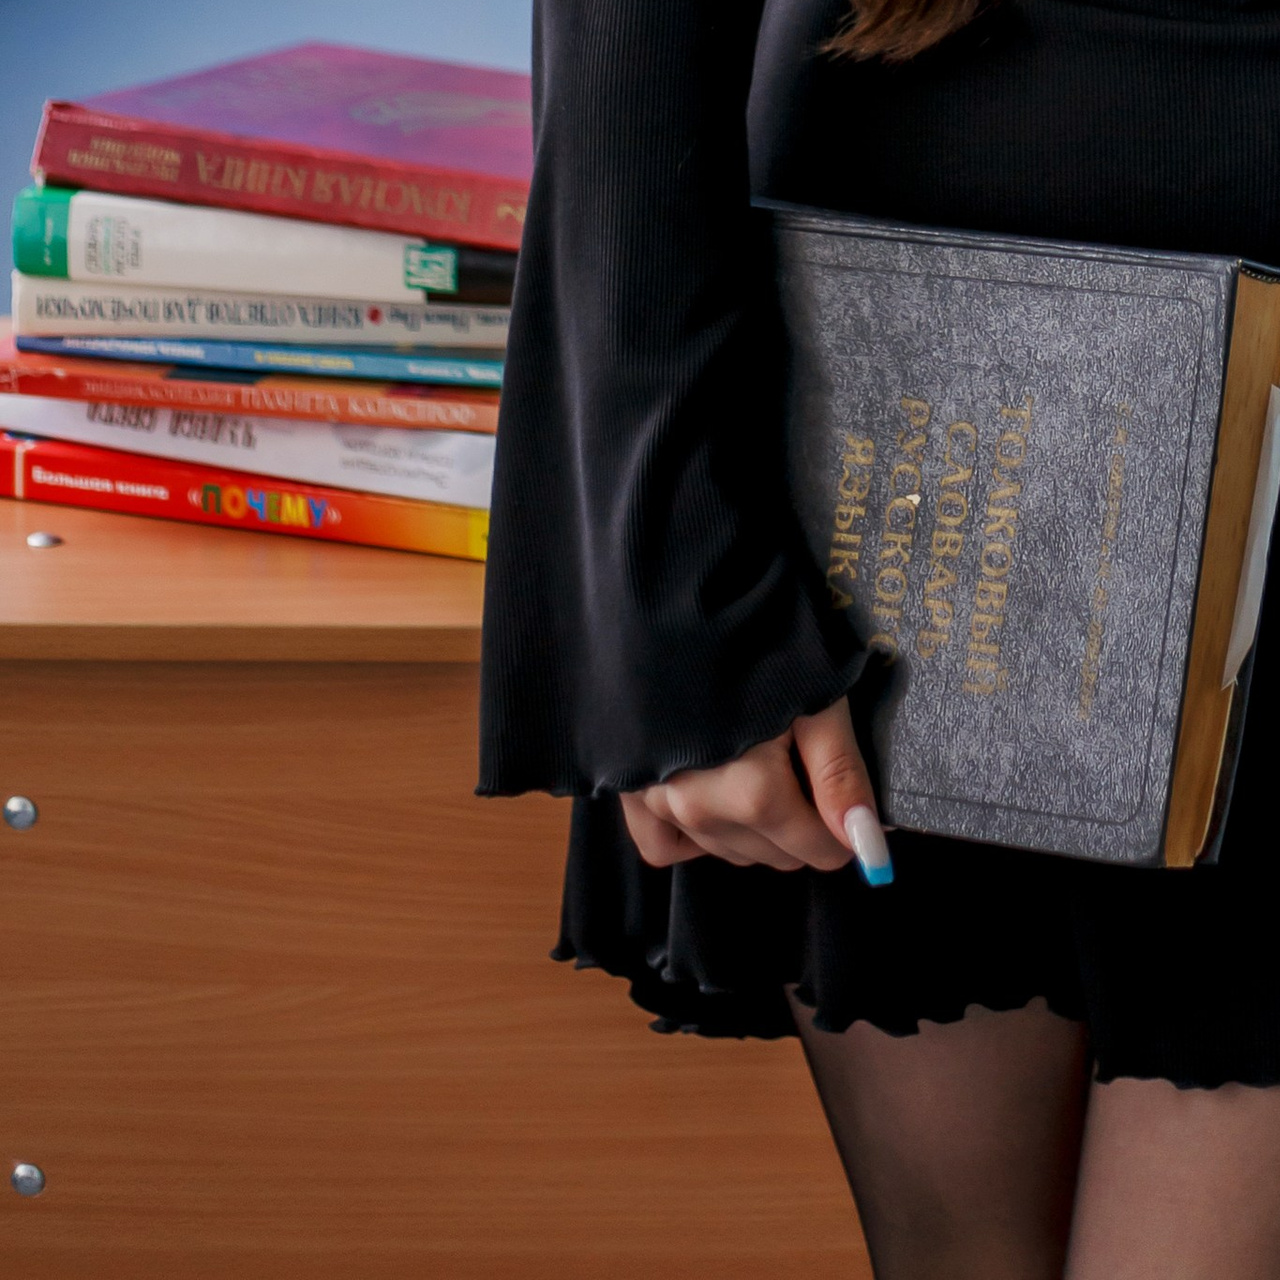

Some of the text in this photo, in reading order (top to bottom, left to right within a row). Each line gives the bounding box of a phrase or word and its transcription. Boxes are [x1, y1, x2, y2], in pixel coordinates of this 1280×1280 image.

[195, 149, 308, 202] КНИГА
[31, 464, 114, 495] Большая
[115, 479, 170, 501] книга
[826, 432, 876, 611] ЯЗЫКА
[867, 396, 931, 667] РУССКОГО
[915, 419, 980, 659] СЛОВАРЬ
[961, 394, 1036, 697] ТОЛКОВЫЙ
